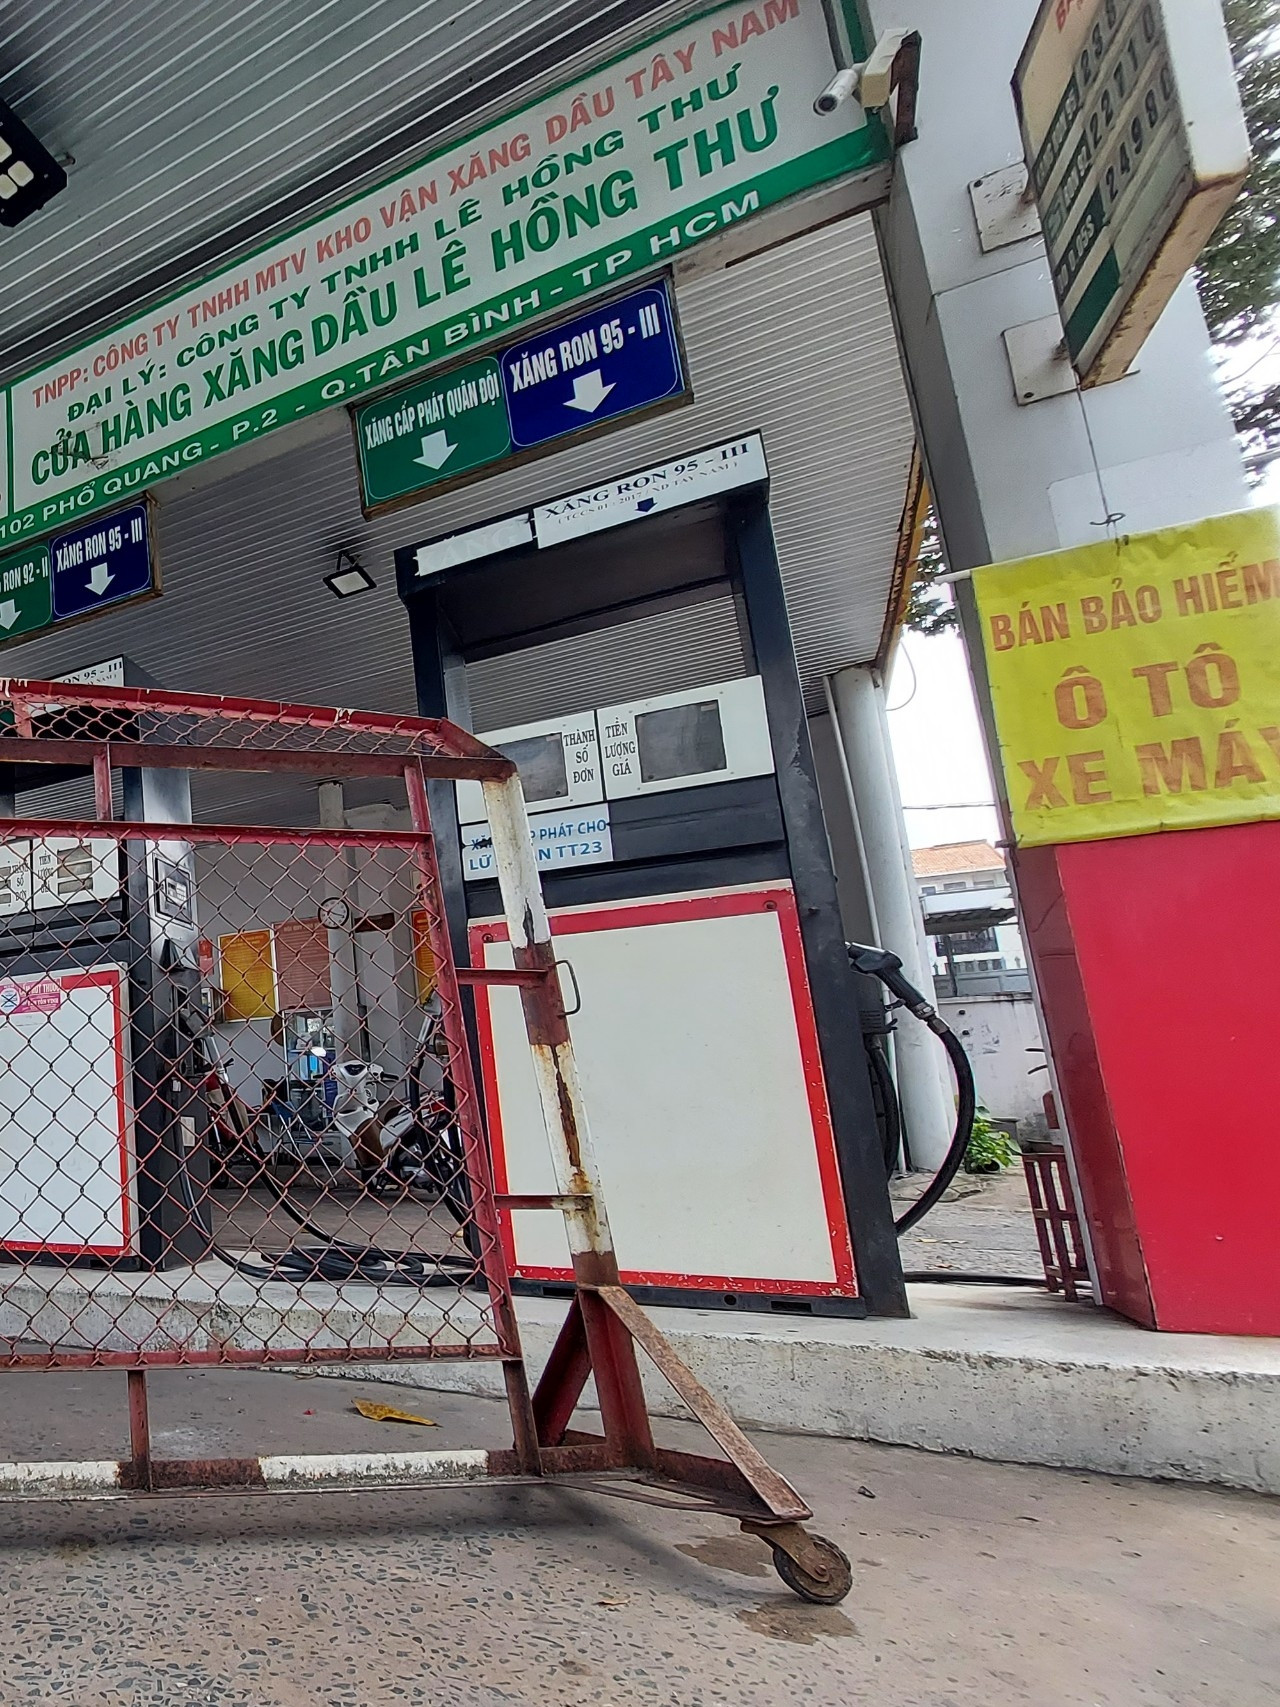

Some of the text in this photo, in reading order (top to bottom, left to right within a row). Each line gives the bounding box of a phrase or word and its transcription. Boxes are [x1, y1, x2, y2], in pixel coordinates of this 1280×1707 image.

[32, 0, 800, 408] TNPP: CÔNG TY TNHH MTV KHO VẬN XĂNG DẦU TÂY NAM
[67, 62, 742, 423] ĐẠI LÝ: CÔNG TY TNHH LÊ HỒNG THƯ
[31, 85, 780, 486] CỬA HÀNG XĂNG DẦU LÊ HỒNG THƯ
[42, 481, 96, 522] PHỔ
[103, 444, 204, 492] QUANG
[232, 408, 278, 442] P.2
[320, 339, 430, 400] Q.TÂN
[444, 288, 541, 347] BÌNH
[572, 250, 633, 287] TP
[650, 190, 760, 256] HCM
[510, 304, 661, 393] XĂNG RON 95 III
[365, 369, 500, 450] XĂNG CẤP PHÁT QUÂN ĐỘI
[545, 443, 749, 518] XĂNG RON 95 III
[56, 517, 143, 572] XĂNG RON 95 III
[4, 564, 21, 592] RON
[23, 562, 34, 585] 92
[42, 556, 49, 577] II
[990, 551, 1280, 651] BÁN BẢO HIỂM
[1054, 642, 1241, 730] Ô TÔ
[563, 729, 596, 747] THÀNH
[575, 745, 589, 764] SỐ
[605, 717, 628, 738] TIỀN
[605, 741, 636, 761] LƯỢNG
[573, 769, 594, 784] ĐƠN
[612, 759, 632, 777] GIÁ
[1017, 750, 1112, 811] XE
[470, 855, 491, 870] LỮ
[556, 841, 603, 858] TT23
[540, 823, 573, 839] PHÁT
[578, 819, 606, 834] CHO
